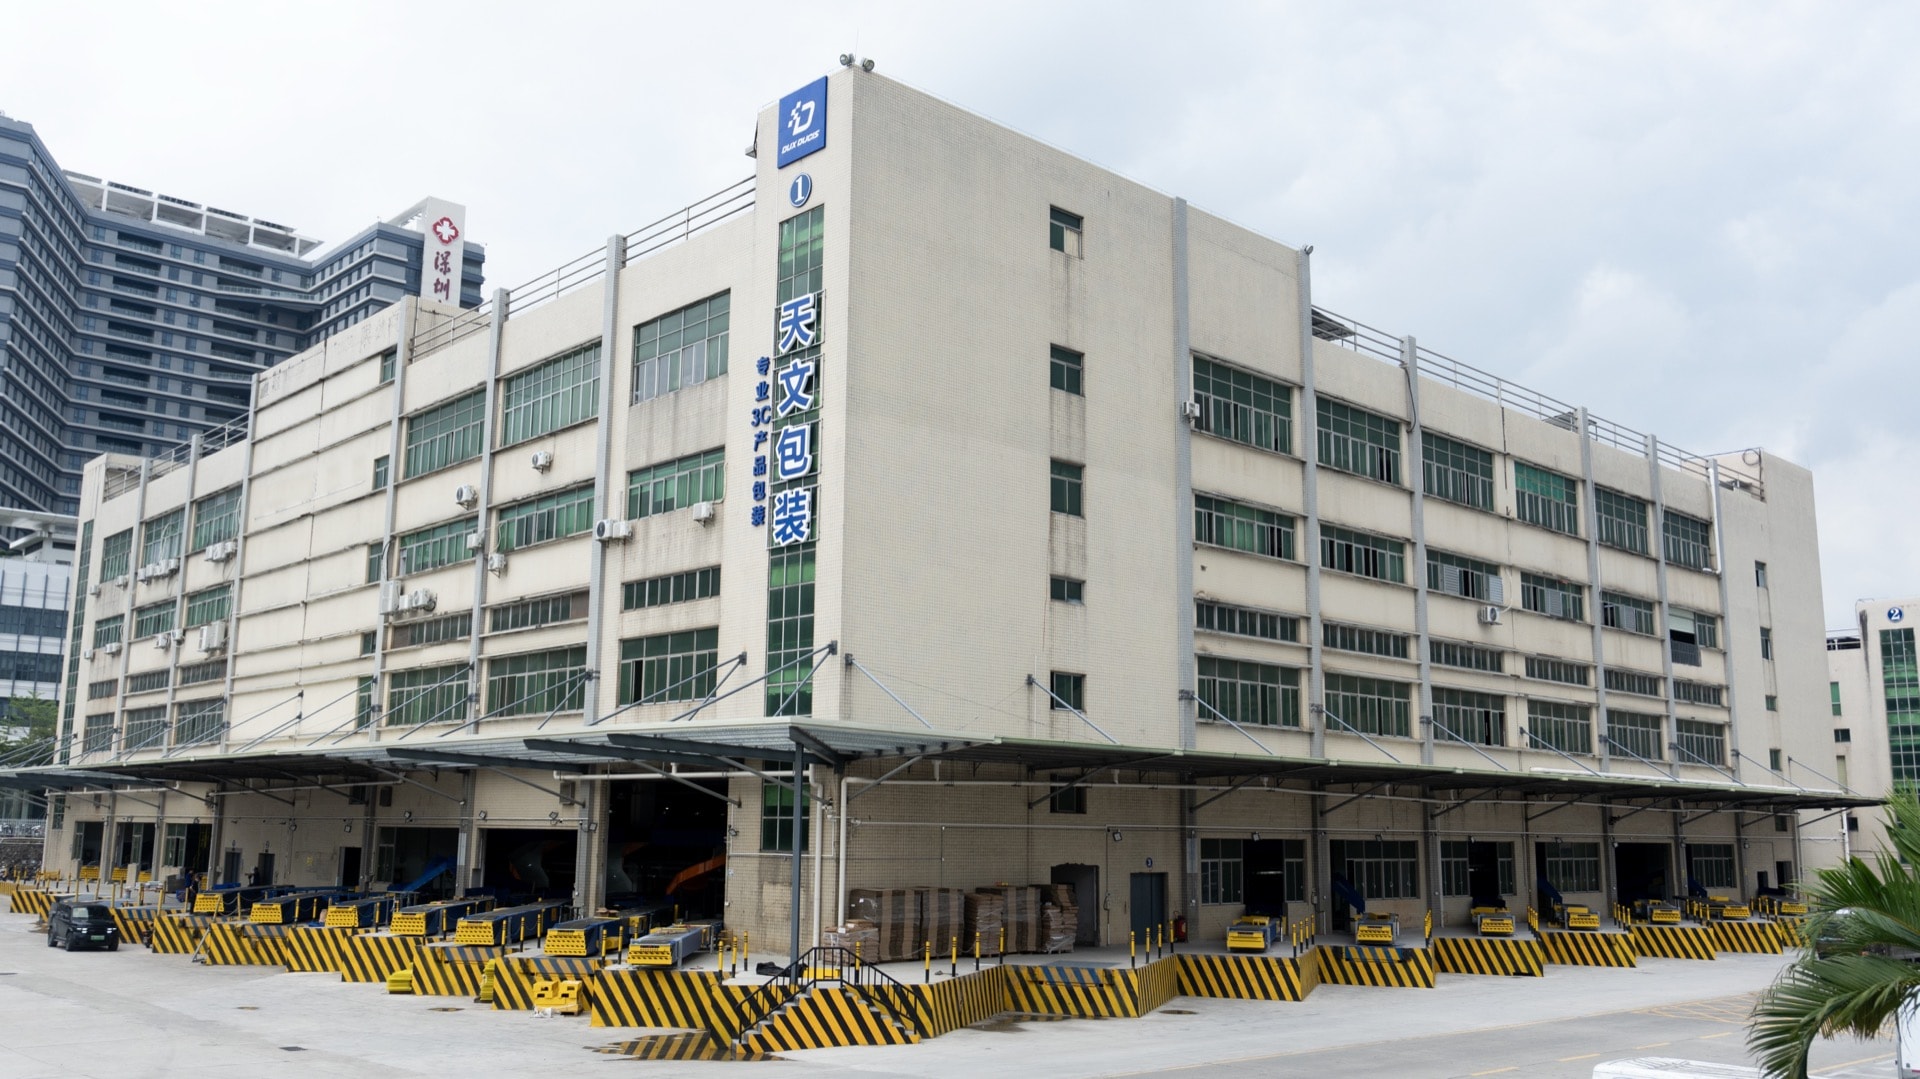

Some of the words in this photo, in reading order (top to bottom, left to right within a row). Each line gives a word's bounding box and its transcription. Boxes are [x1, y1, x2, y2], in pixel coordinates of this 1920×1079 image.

[781, 138, 798, 154] DUX
[797, 129, 820, 149] DUCIS
[794, 175, 805, 203] 1
[433, 251, 451, 303] 深圳
[774, 293, 815, 545] 天文包装
[751, 356, 772, 527] 专业3C产品包装
[1890, 608, 1901, 620] 2
